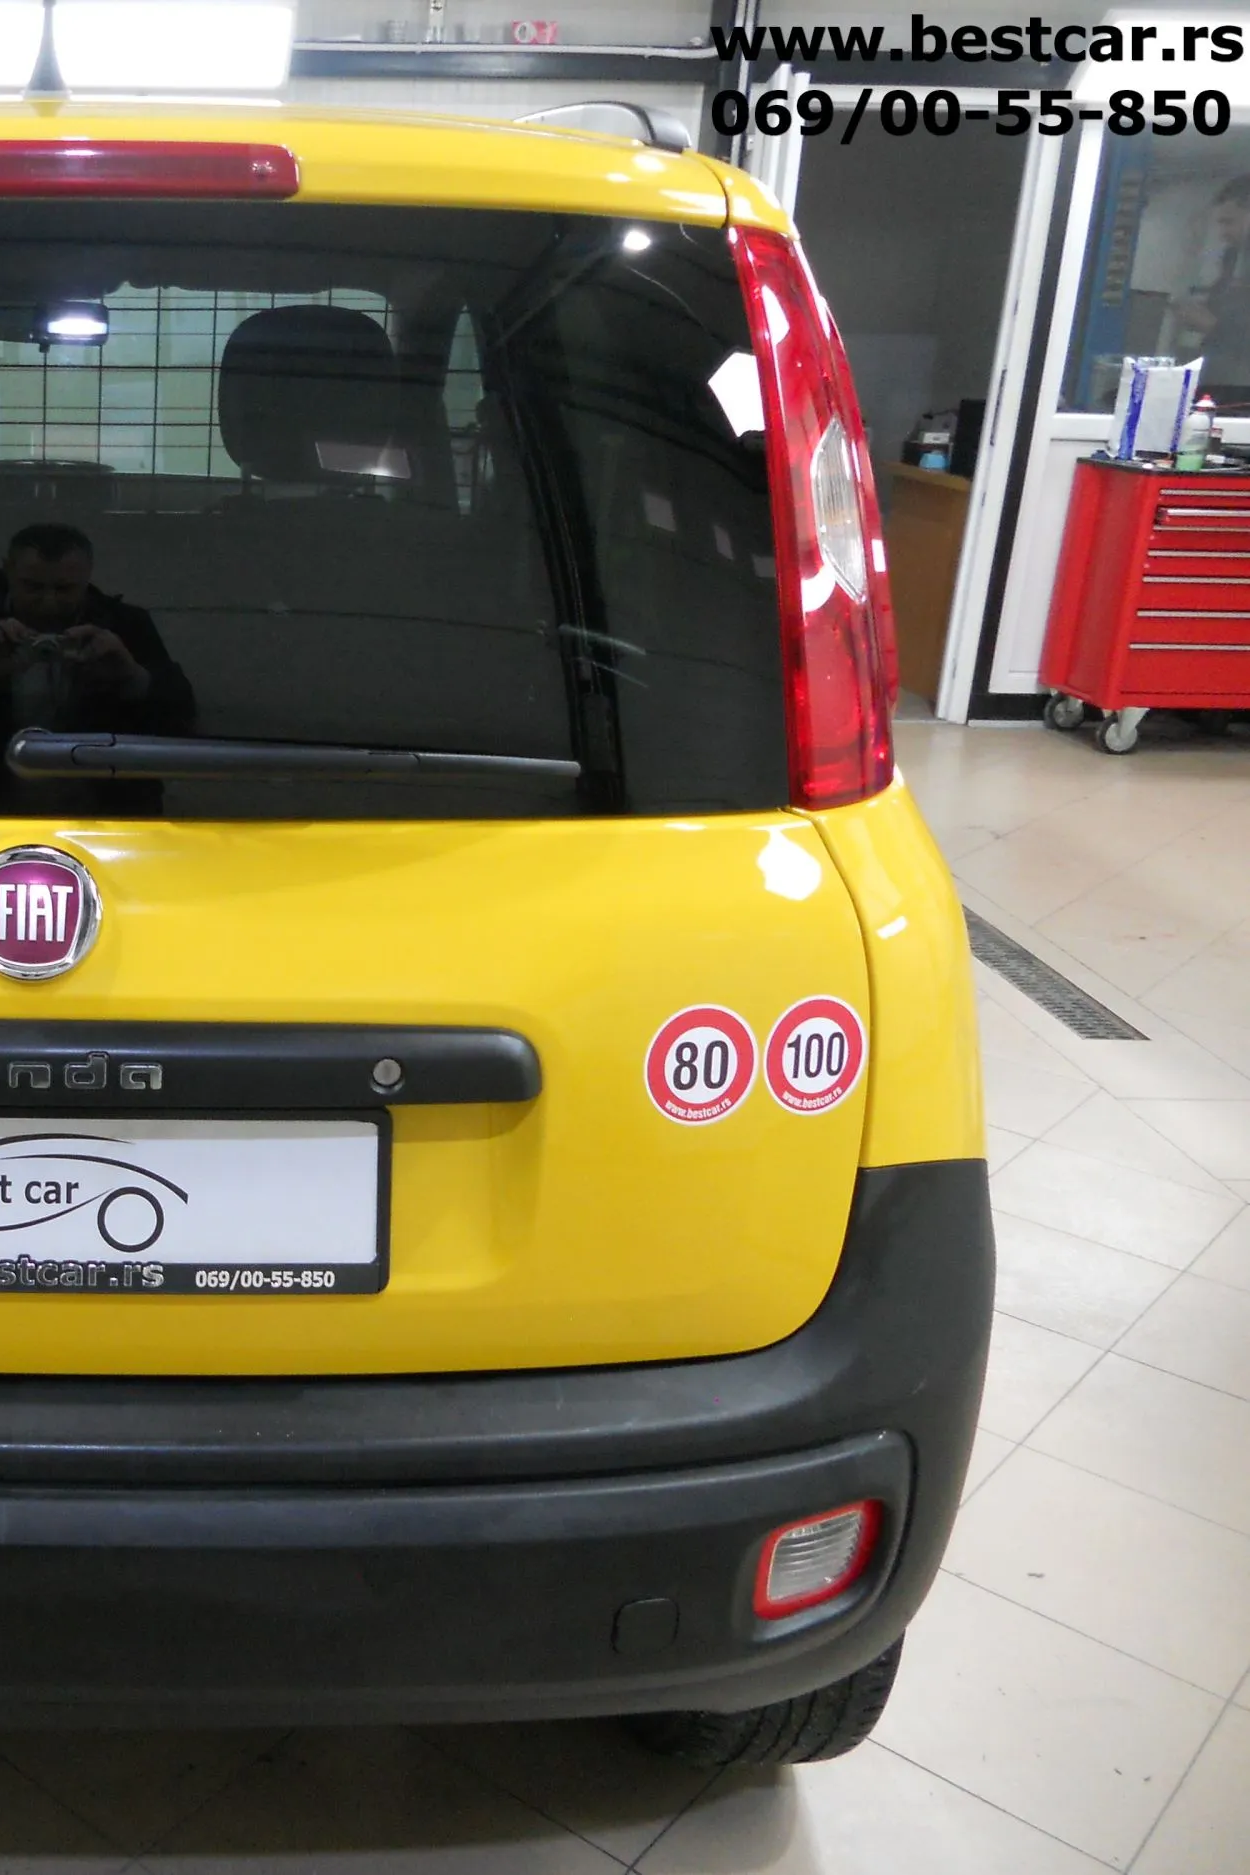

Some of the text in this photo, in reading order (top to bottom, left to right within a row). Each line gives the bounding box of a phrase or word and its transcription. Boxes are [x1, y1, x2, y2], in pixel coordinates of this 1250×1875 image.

[672, 1040, 729, 1091] 80
[787, 1031, 845, 1079] 100
[665, 1098, 732, 1120] www.bestcar.rs
[781, 1086, 843, 1109] www.bestcar.rs
[24, 1180, 79, 1204] car
[195, 1270, 336, 1291] 069/00-55-850
